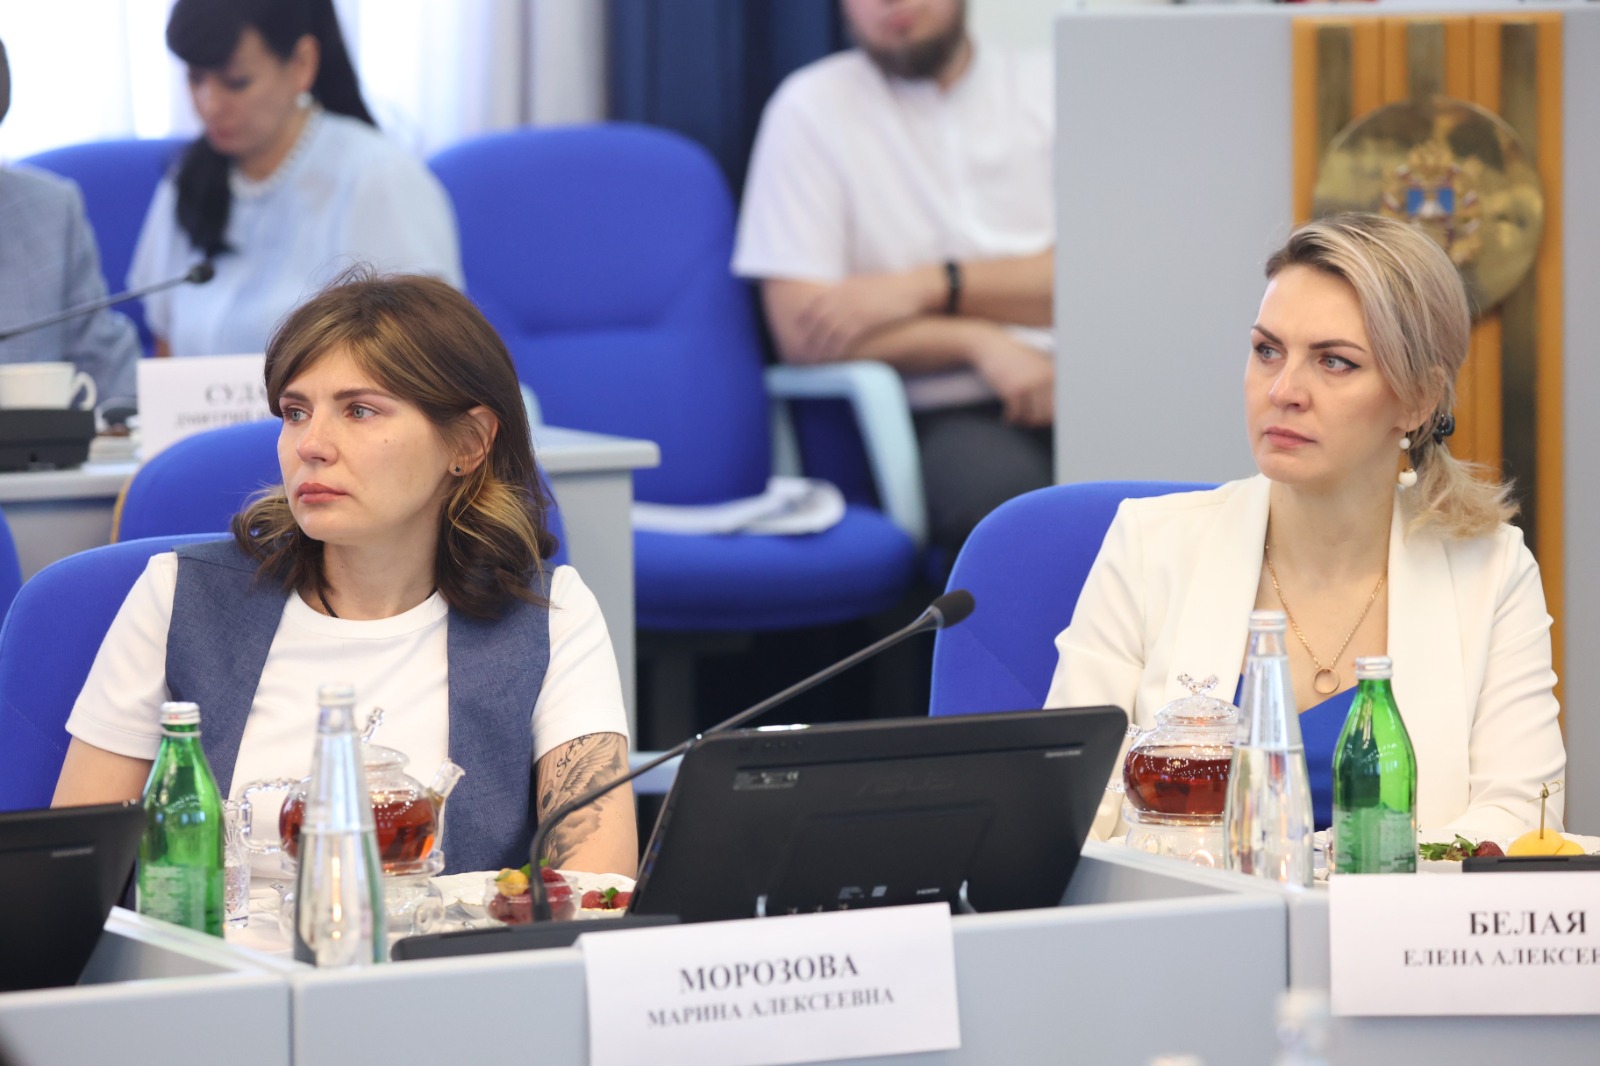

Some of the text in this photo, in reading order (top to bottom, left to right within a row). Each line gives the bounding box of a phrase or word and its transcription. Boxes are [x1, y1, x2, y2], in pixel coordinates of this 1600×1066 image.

[1469, 910, 1586, 936] БЕЛАЯ
[679, 953, 859, 993] МОРОЗОВА
[1404, 948, 1484, 967] ЕЛЕНА
[646, 987, 895, 1028] МАРИНА АЛЕКСЕЕВНА
